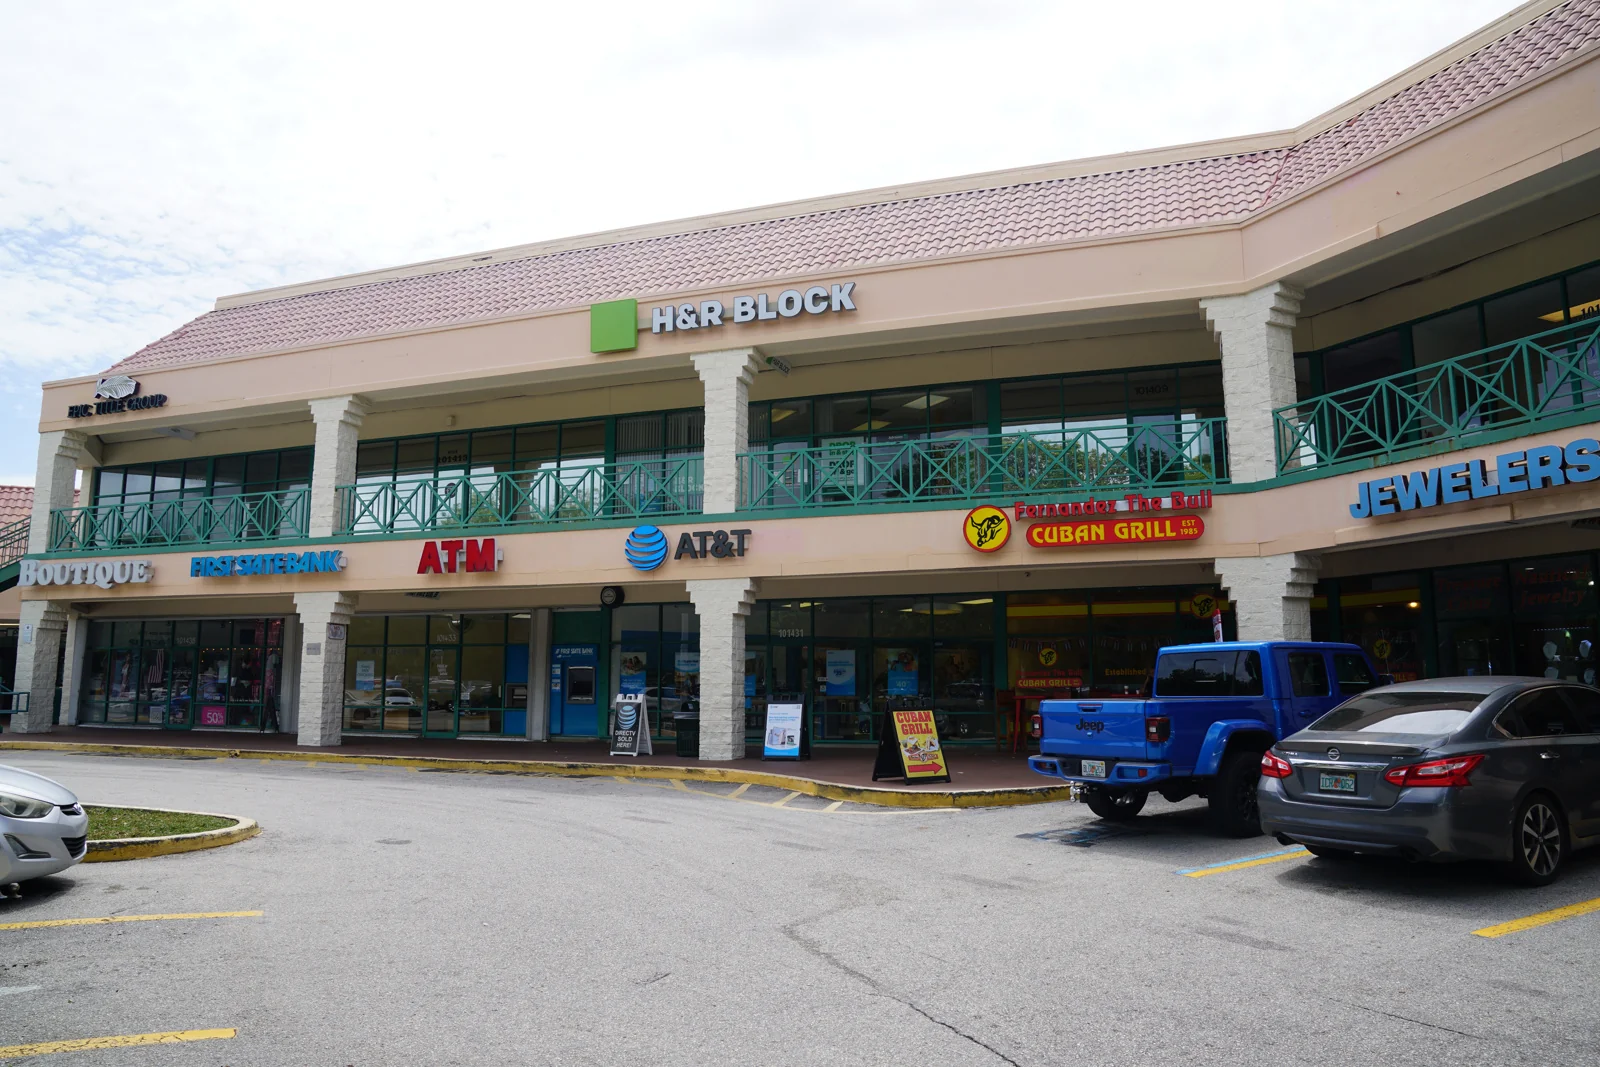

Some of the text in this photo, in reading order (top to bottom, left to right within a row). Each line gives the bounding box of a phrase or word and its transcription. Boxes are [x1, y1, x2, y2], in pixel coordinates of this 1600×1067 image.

[652, 282, 857, 334] H&R BLOCK
[67, 394, 168, 418] EPIC TITLE GROUP
[1349, 438, 1600, 519] JEWELERS
[1014, 489, 1212, 521] Fernandez The Bull
[1032, 520, 1177, 543] CUBAN GRILL
[1182, 519, 1196, 527] EST
[417, 538, 498, 574] ATM
[674, 529, 751, 560] AT&T
[17, 559, 153, 589] BOUTIQUE
[191, 550, 343, 577] FIRST STATE BANK
[1519, 587, 1584, 612] Jewelry
[778, 628, 804, 638] 101431
[1018, 680, 1046, 688] CUBAN
[1048, 679, 1073, 687] GRILL
[1105, 667, 1147, 676] Established
[896, 711, 932, 723] CUBAN
[901, 723, 933, 735] GRILL
[1075, 717, 1105, 734] Jeep
